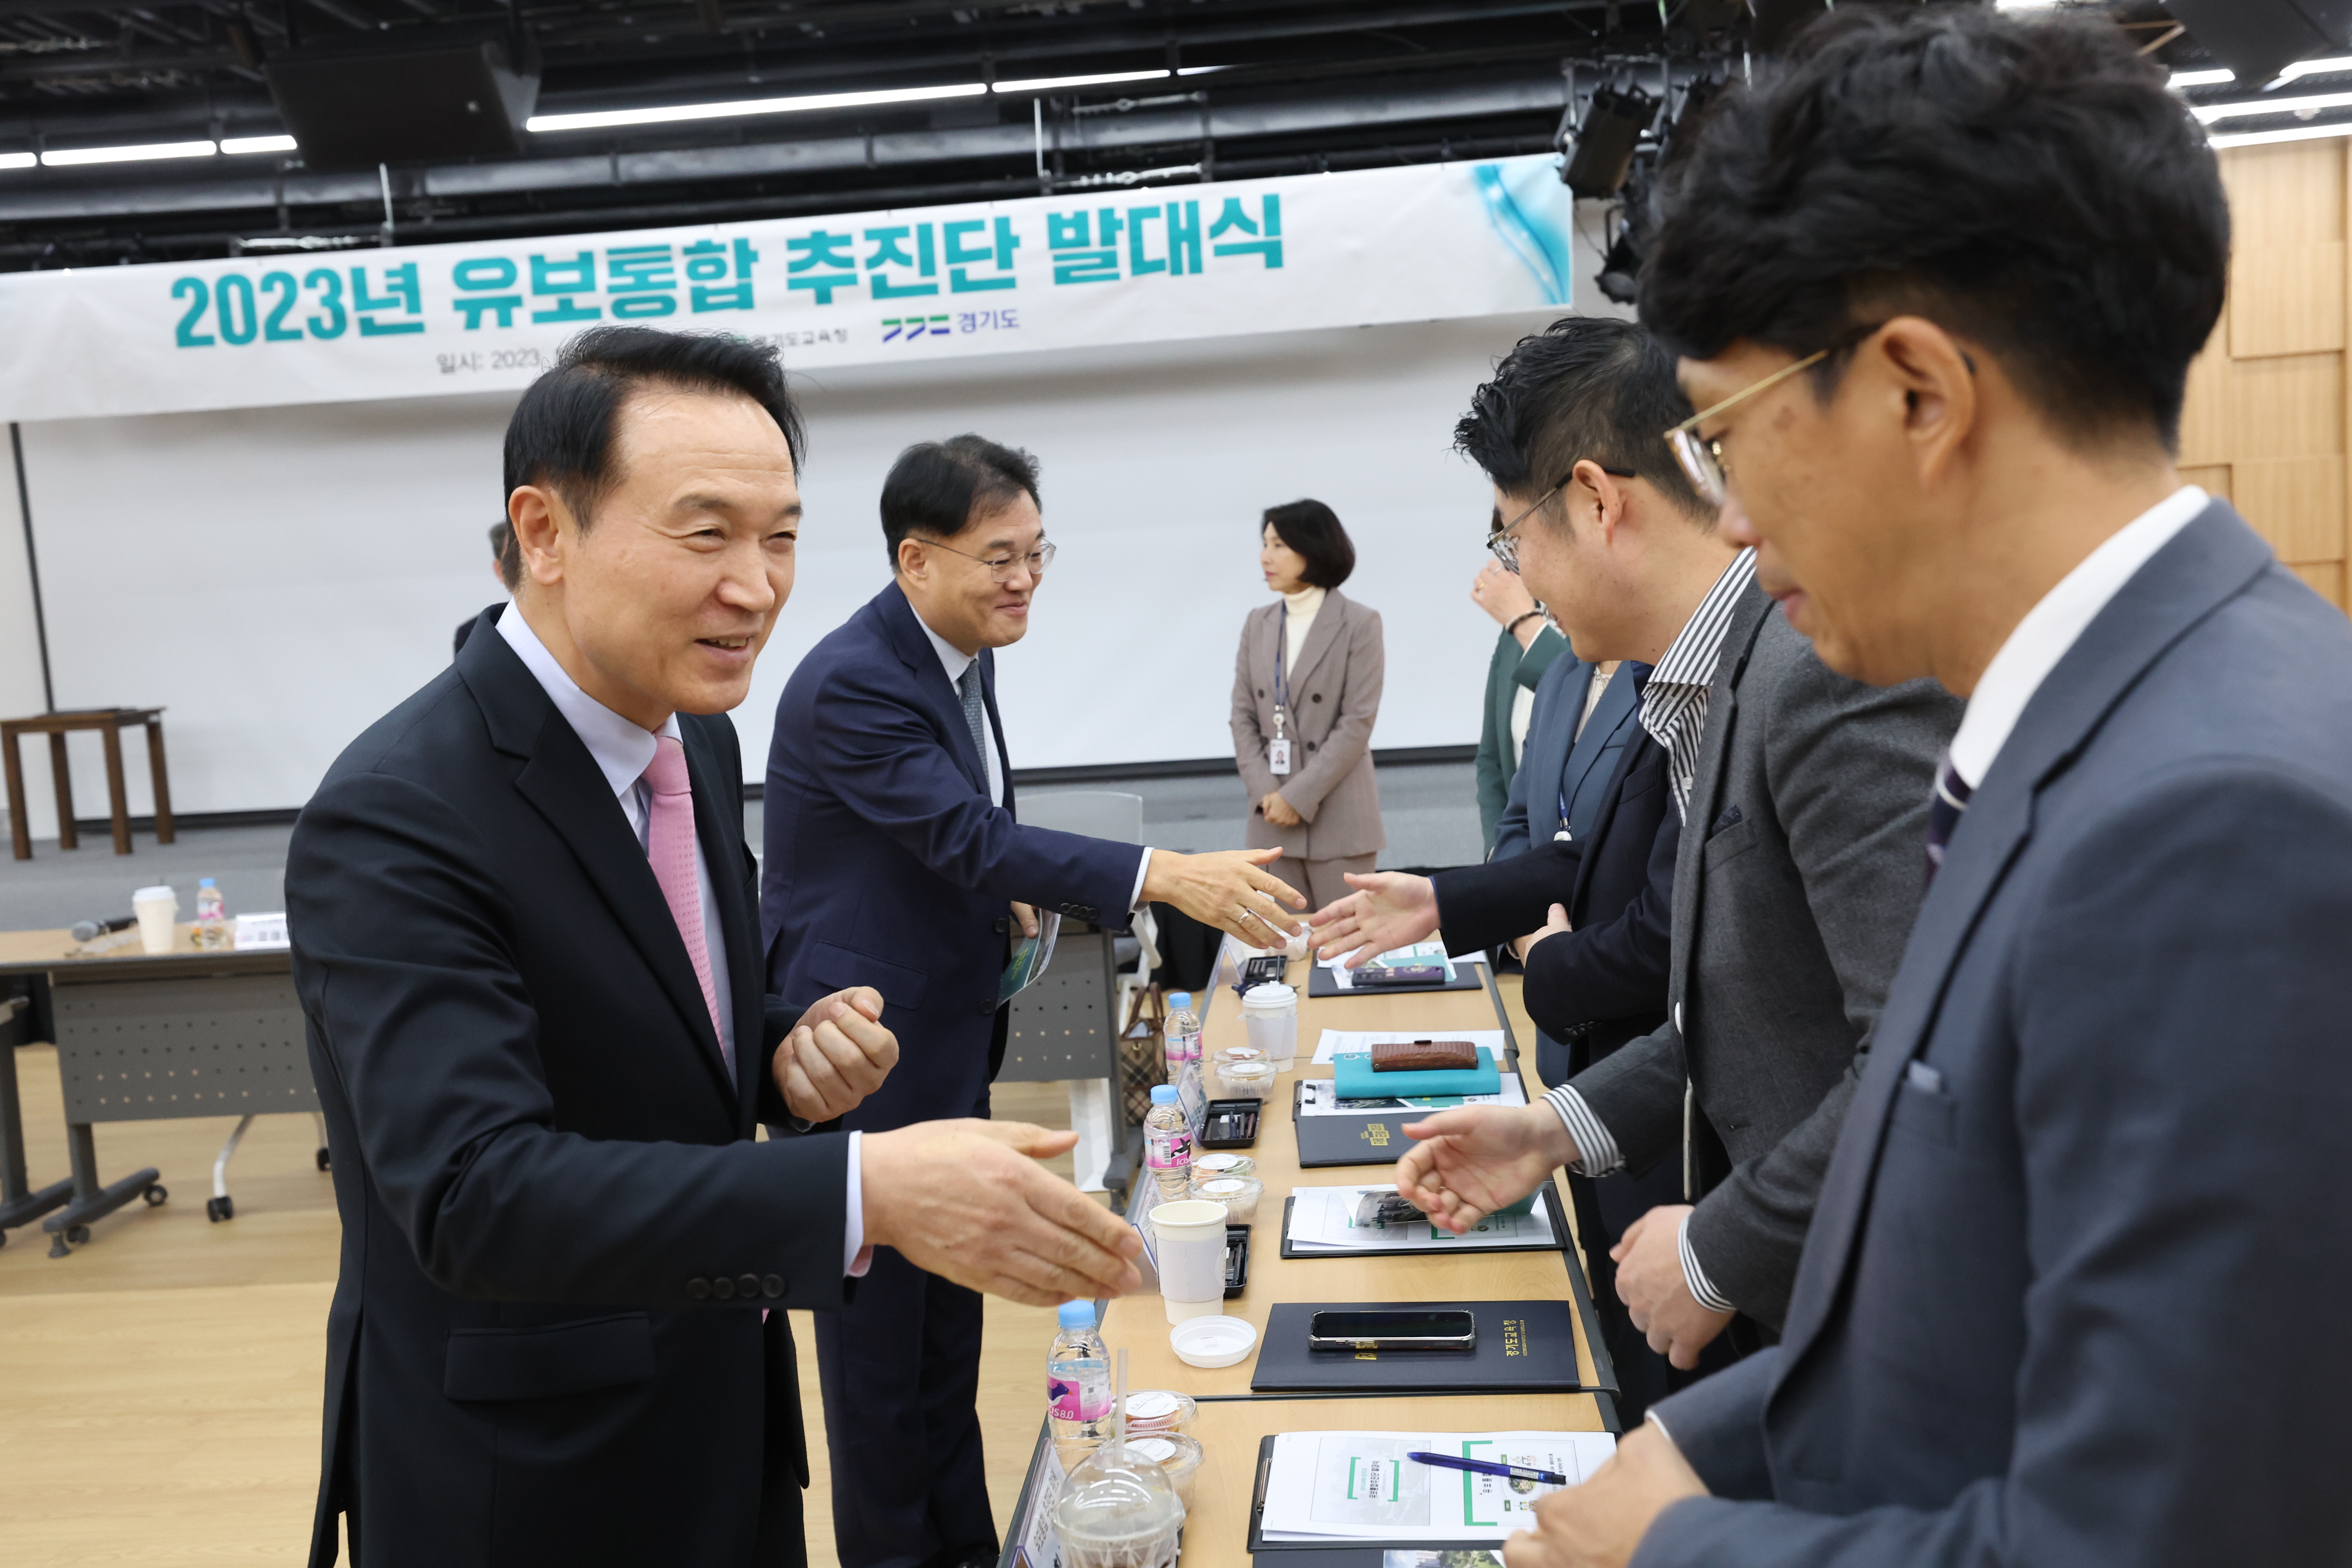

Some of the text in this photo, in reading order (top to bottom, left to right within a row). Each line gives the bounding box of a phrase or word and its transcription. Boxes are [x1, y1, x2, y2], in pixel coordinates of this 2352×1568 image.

[172, 193, 1283, 348] 2023년 유보통합 추진단 발대식
[958, 309, 1019, 333] 경기도
[436, 352, 484, 374] 일시:
[1503, 1320, 1519, 1356] 경기도교육청
